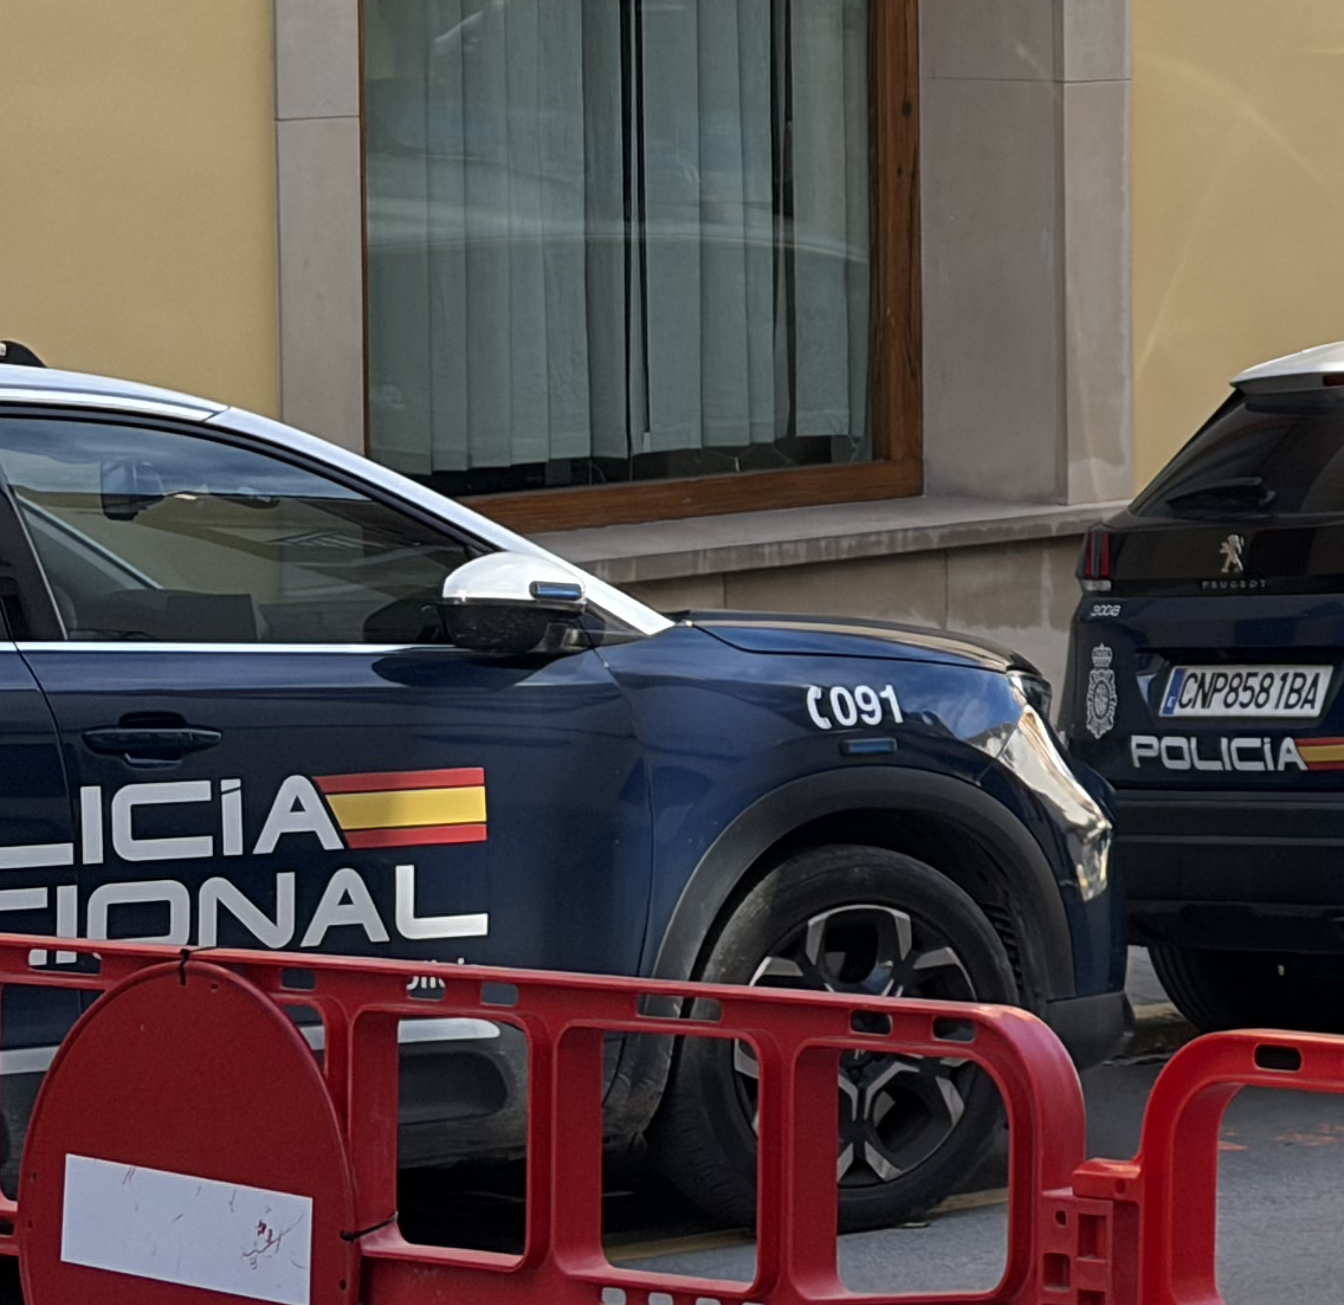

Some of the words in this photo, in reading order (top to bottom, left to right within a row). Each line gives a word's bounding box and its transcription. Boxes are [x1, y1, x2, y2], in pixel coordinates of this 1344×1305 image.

[1201, 579, 1267, 590] PEUGEOT
[829, 684, 904, 727] 091
[1178, 671, 1322, 711] CNP8581BA
